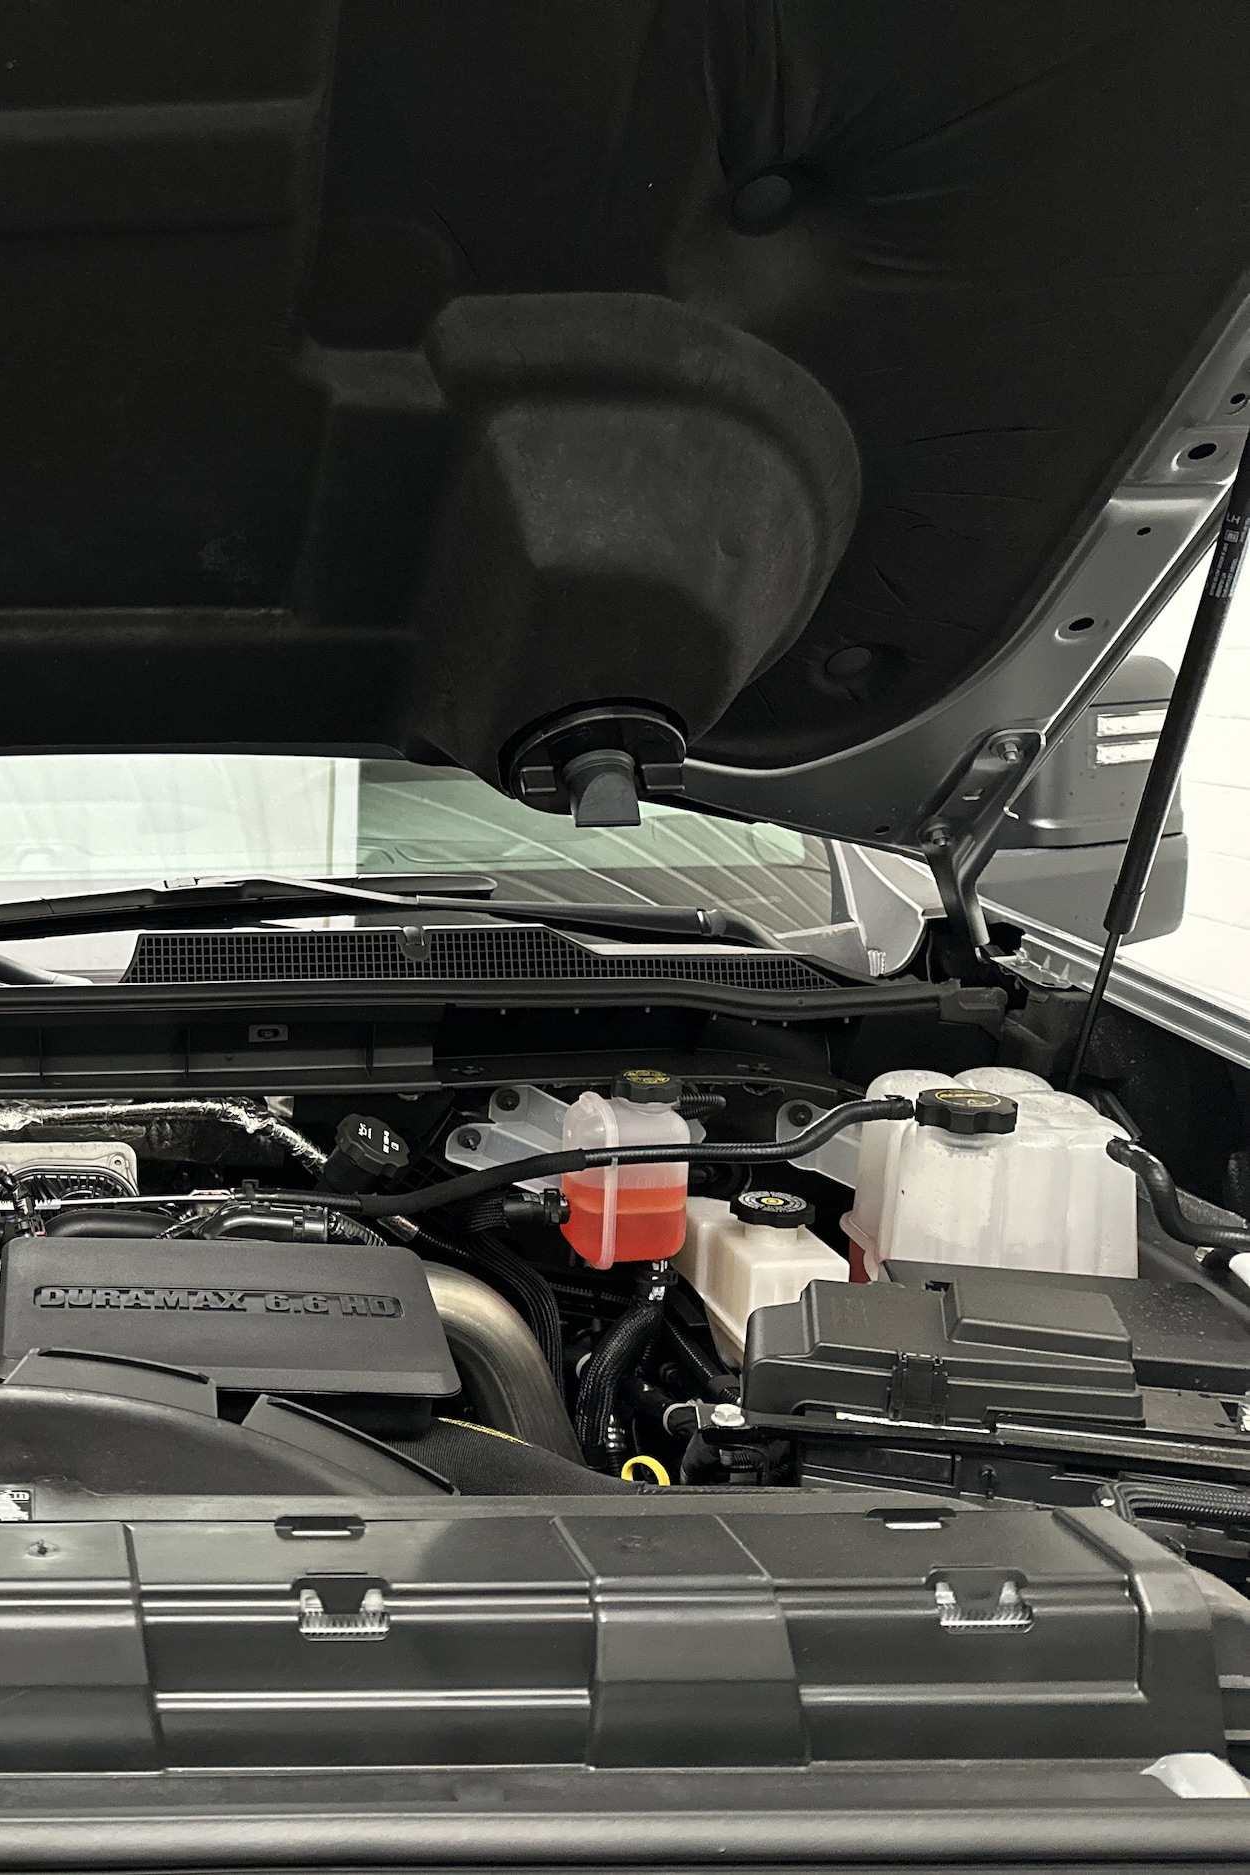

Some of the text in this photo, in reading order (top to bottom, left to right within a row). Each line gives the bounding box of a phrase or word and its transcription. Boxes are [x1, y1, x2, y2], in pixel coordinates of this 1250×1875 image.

[40, 1288, 400, 1318] DURAMAX 6.6 HD
